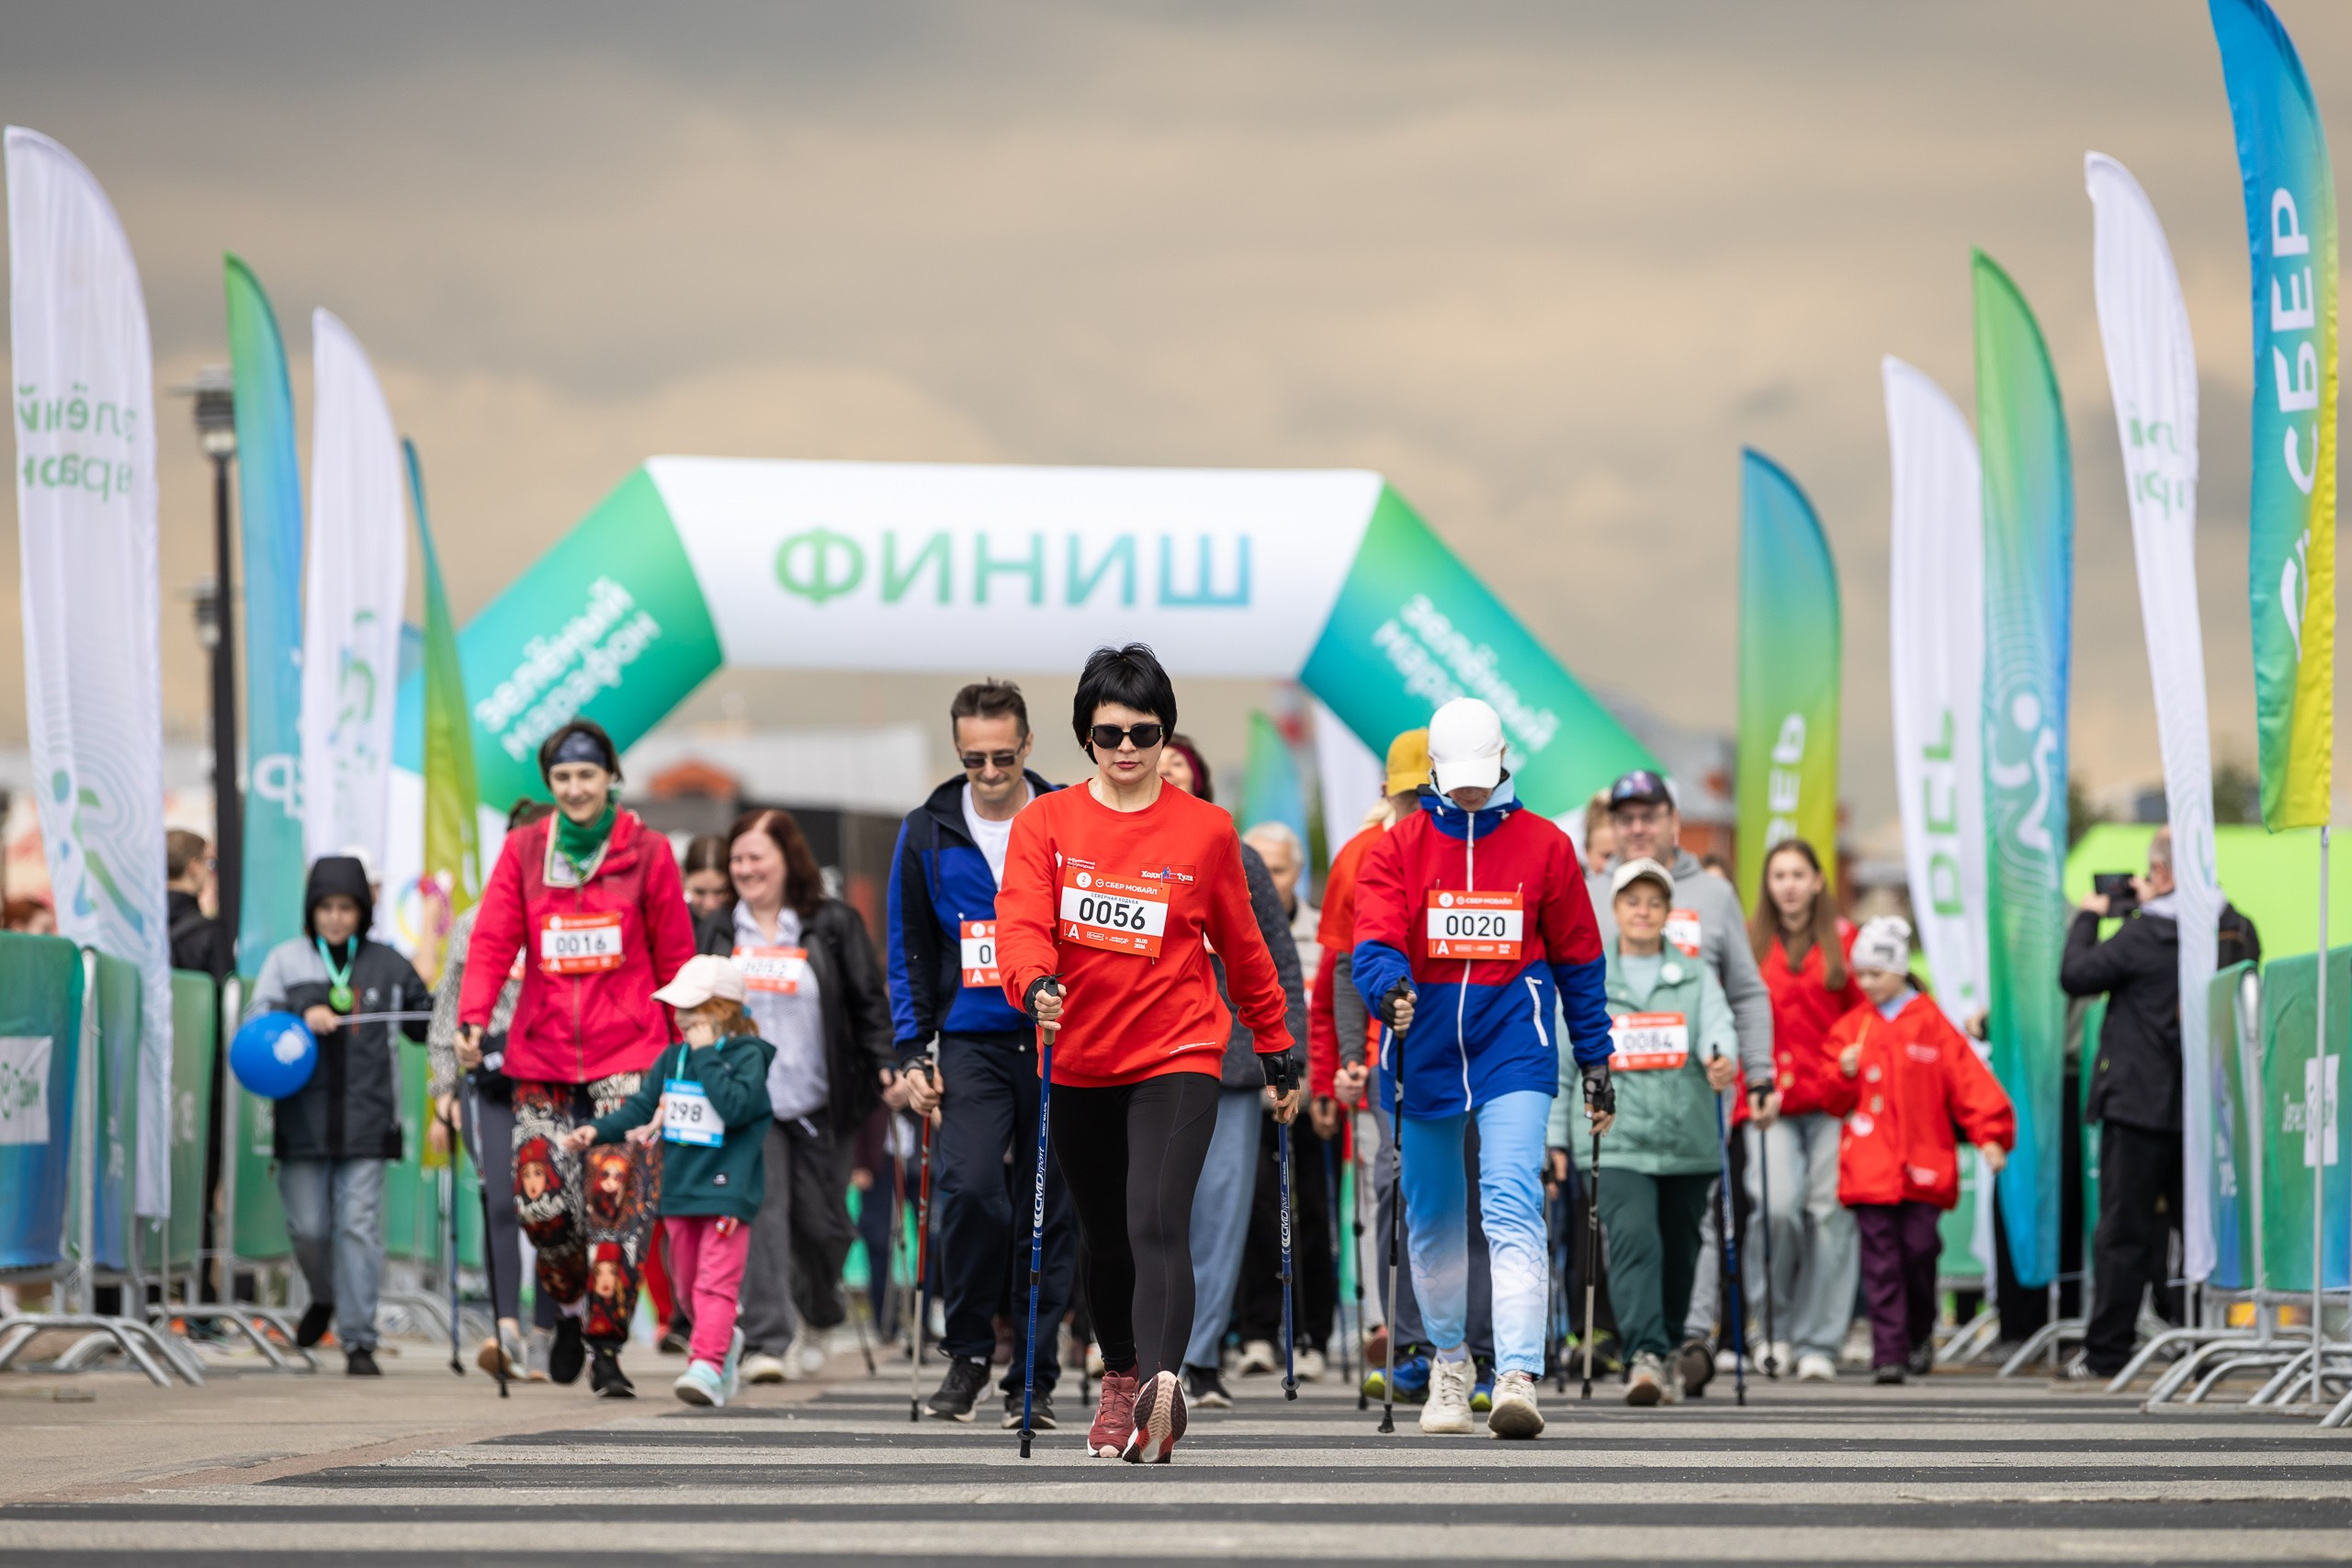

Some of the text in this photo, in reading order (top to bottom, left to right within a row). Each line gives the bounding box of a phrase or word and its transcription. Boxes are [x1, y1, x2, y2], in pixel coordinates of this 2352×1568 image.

[2271, 187, 2319, 495] СБЕР
[774, 527, 1250, 605] ФИНИШ
[1091, 892, 1118, 901] СЕВЕРНАЯ
[1105, 881, 1158, 895] СБЕР МОБАЙЛ
[1079, 897, 1146, 931] 0056
[1446, 915, 1506, 937] 0020
[556, 934, 606, 953] 0016
[671, 1101, 703, 1122] 298
